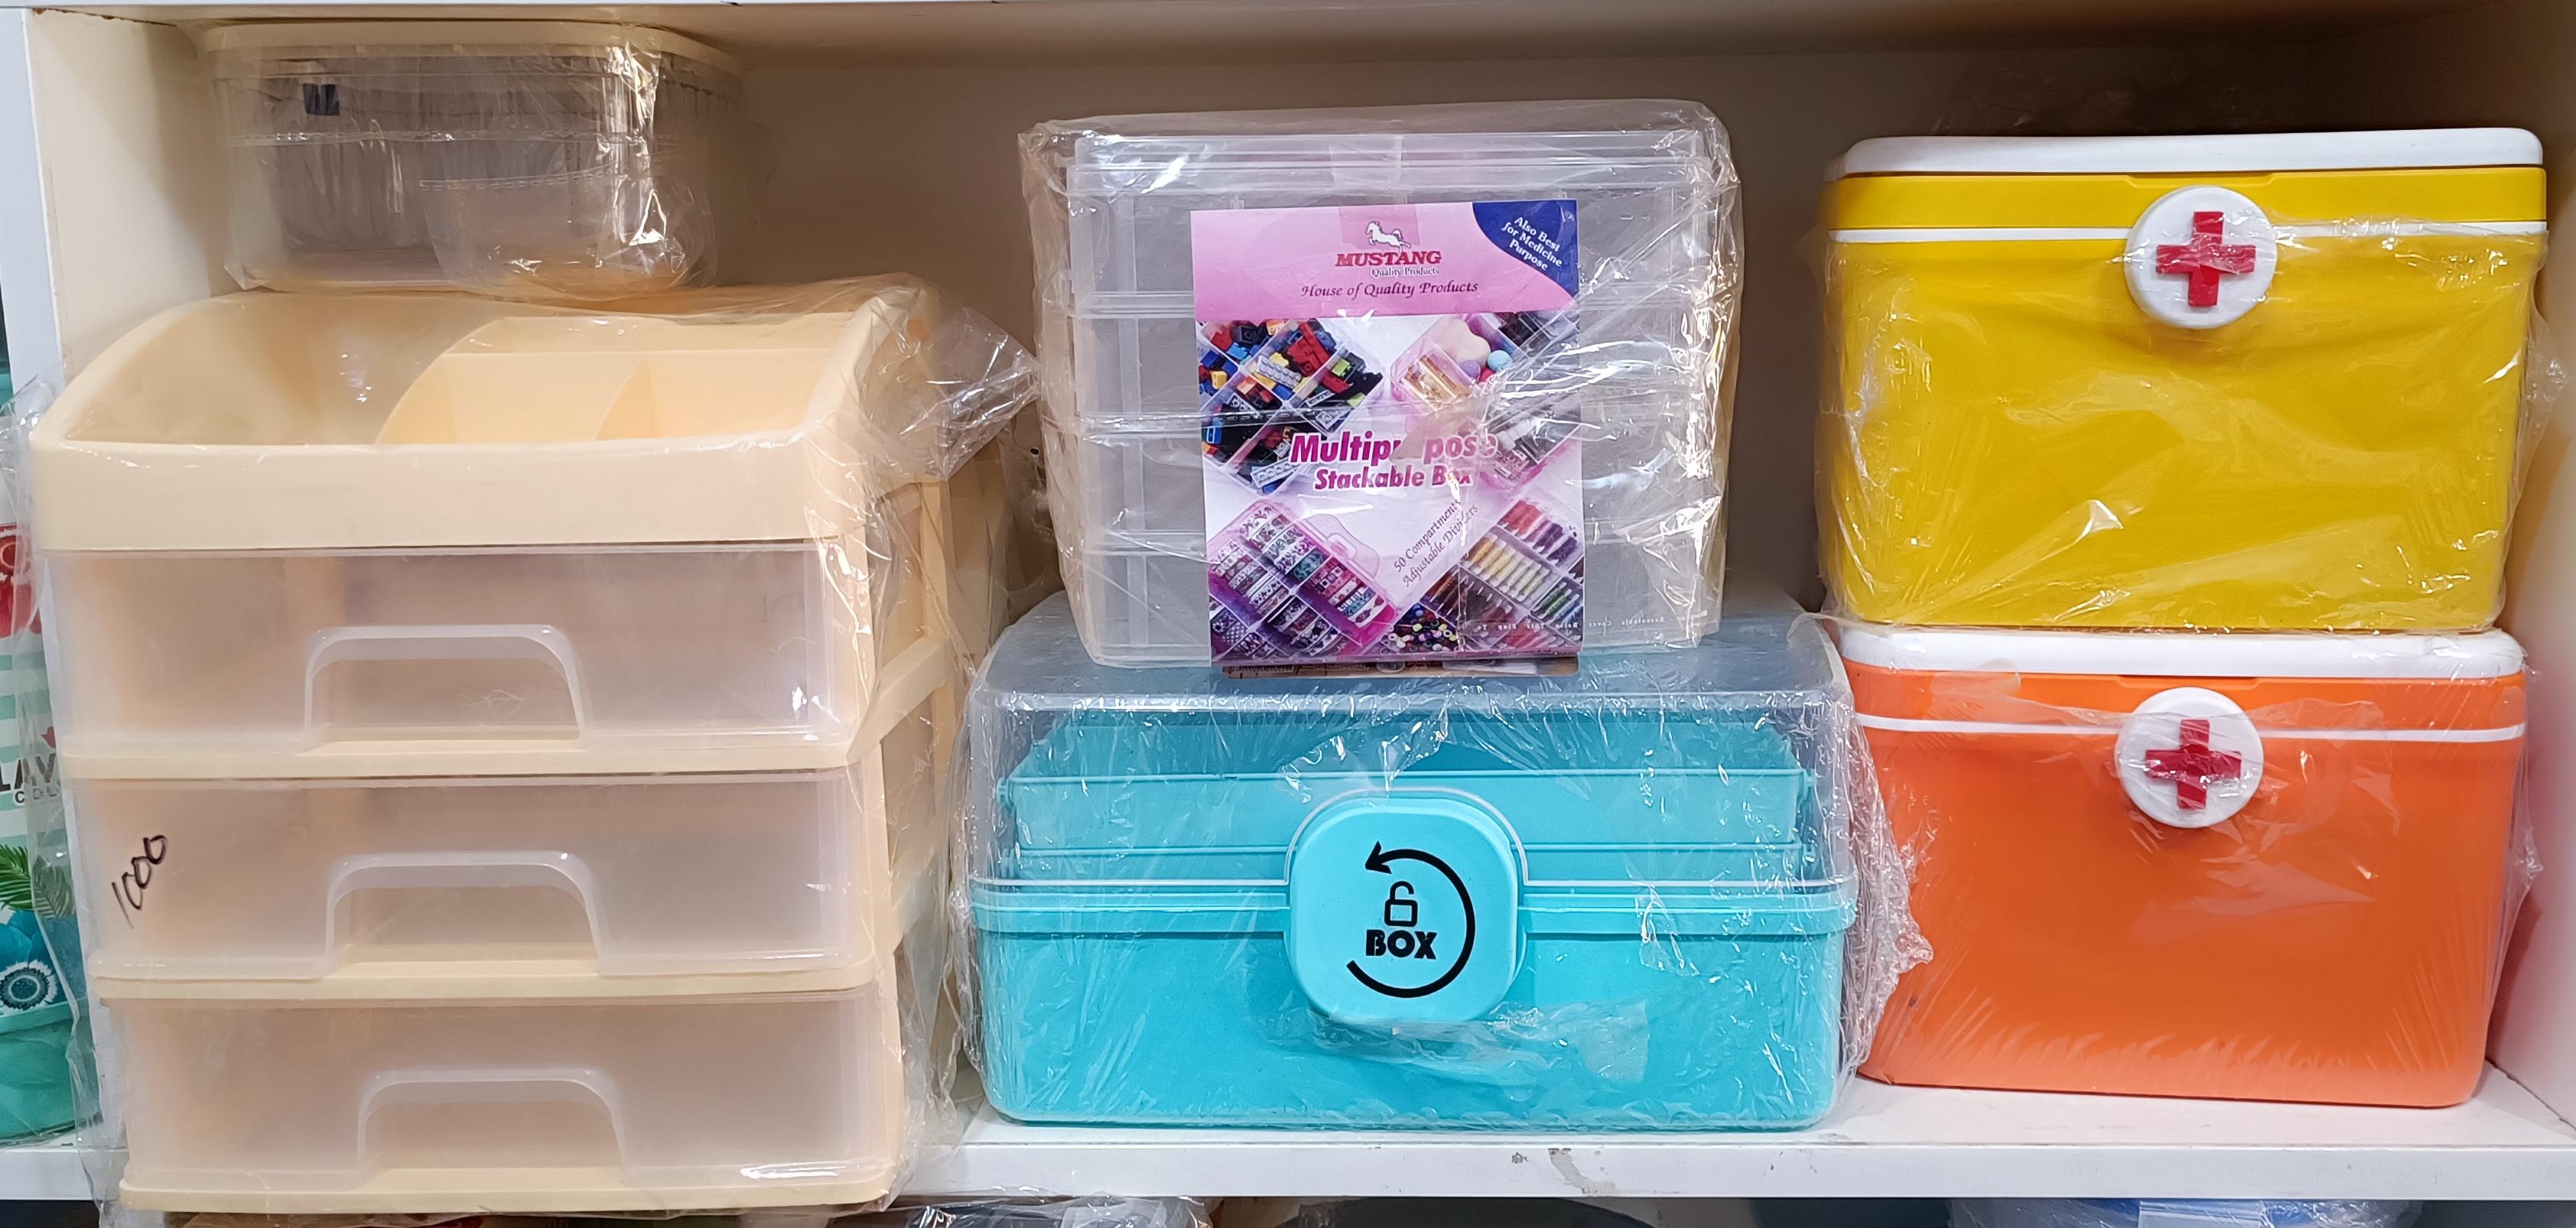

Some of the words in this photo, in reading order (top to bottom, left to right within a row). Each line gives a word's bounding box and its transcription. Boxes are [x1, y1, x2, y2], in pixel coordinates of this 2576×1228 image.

[1501, 222, 1519, 236] for
[1519, 232, 1563, 267] Medicine
[1514, 216, 1537, 236] Also
[1537, 231, 1560, 252] Best
[1335, 251, 1442, 267] MUSTANG
[1509, 239, 1548, 271] Purpose
[1301, 284, 1342, 297] House
[1347, 283, 1363, 300] of
[1364, 282, 1414, 298] Quality
[1419, 280, 1478, 294] Products
[1371, 268, 1402, 278] Quality
[1290, 430, 1498, 466] Multippose
[1315, 465, 1424, 489] Stackable
[1394, 557, 1407, 573] 50
[1405, 499, 1461, 560] Compartments
[1403, 541, 1445, 587] Adjustable
[111, 834, 167, 930] 1000
[1366, 929, 1437, 960] BOX
